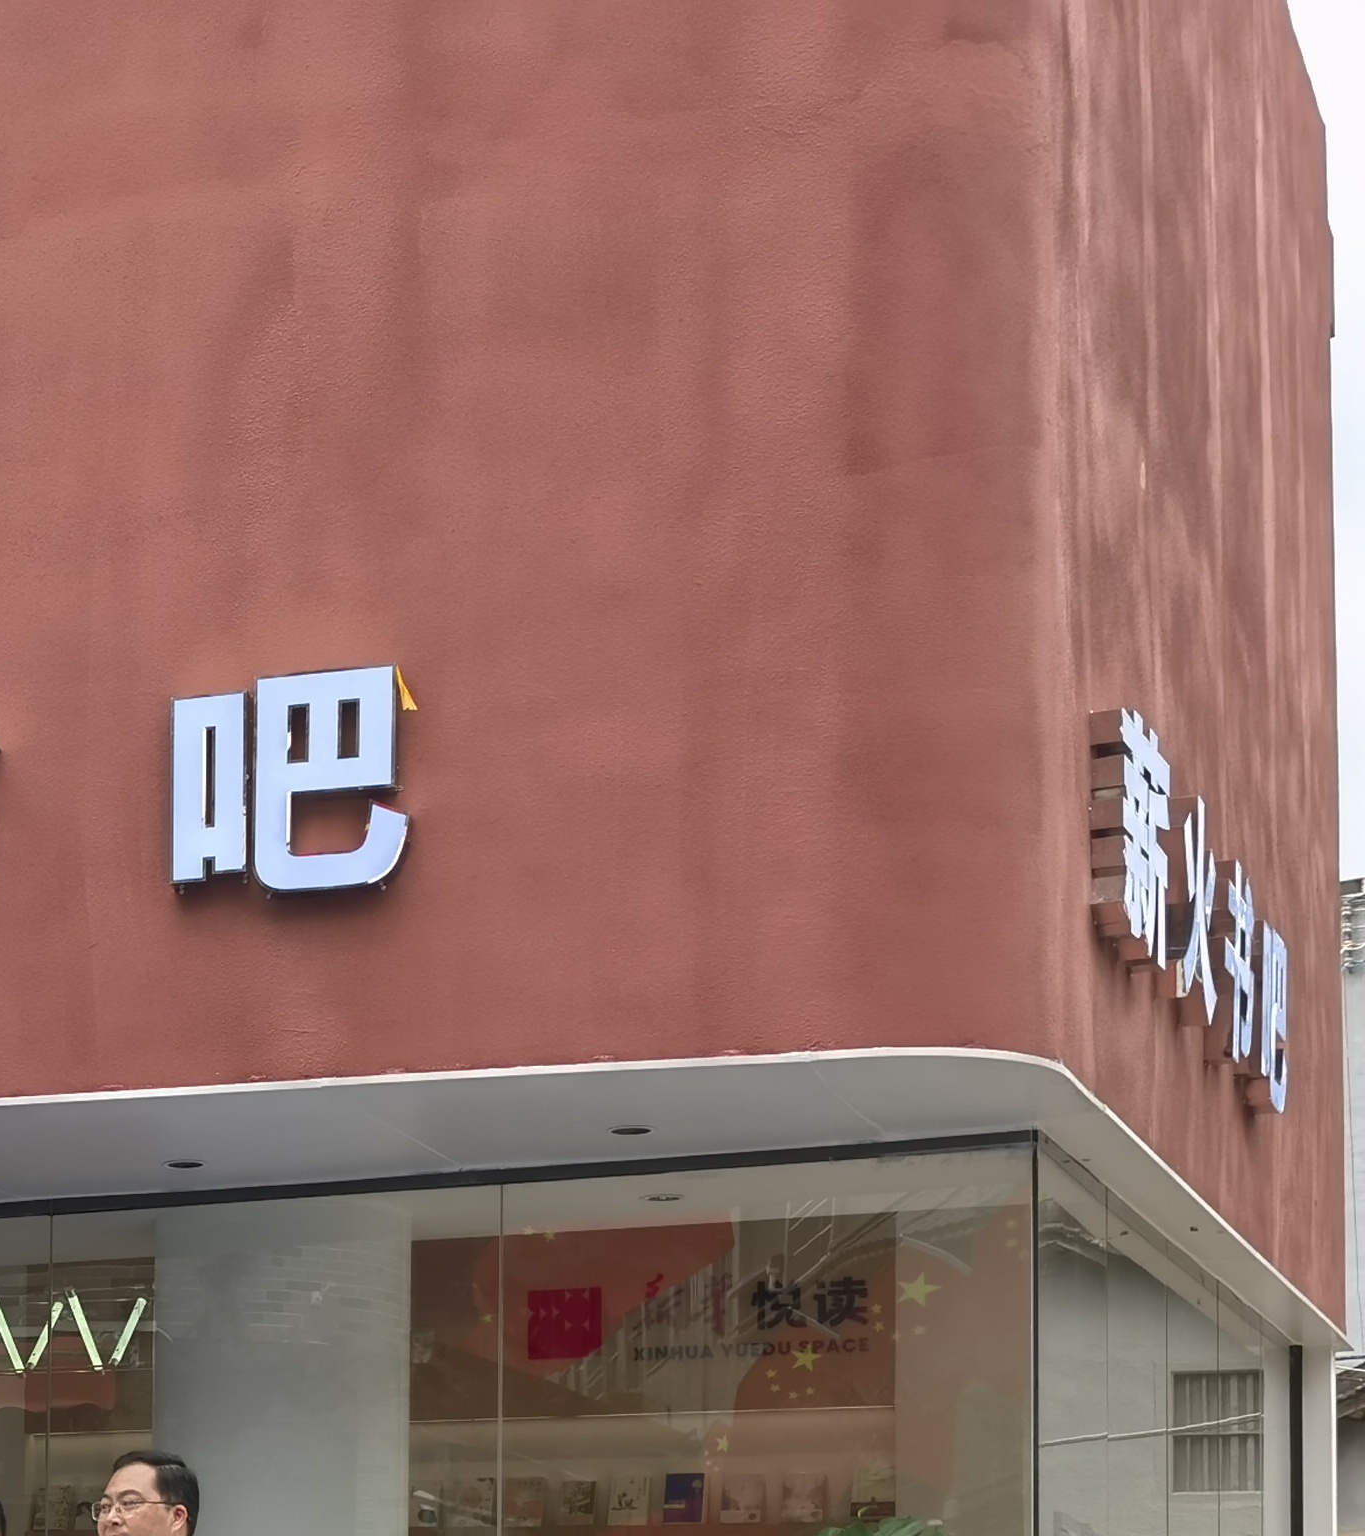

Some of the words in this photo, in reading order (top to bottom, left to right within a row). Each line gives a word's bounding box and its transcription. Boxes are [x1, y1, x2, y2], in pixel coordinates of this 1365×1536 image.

[1120, 708, 1287, 1113] 薪火书吧
[634, 1345, 714, 1361] XINHUA
[721, 1342, 791, 1358] YUEDU
[799, 1338, 869, 1354] SPACE
